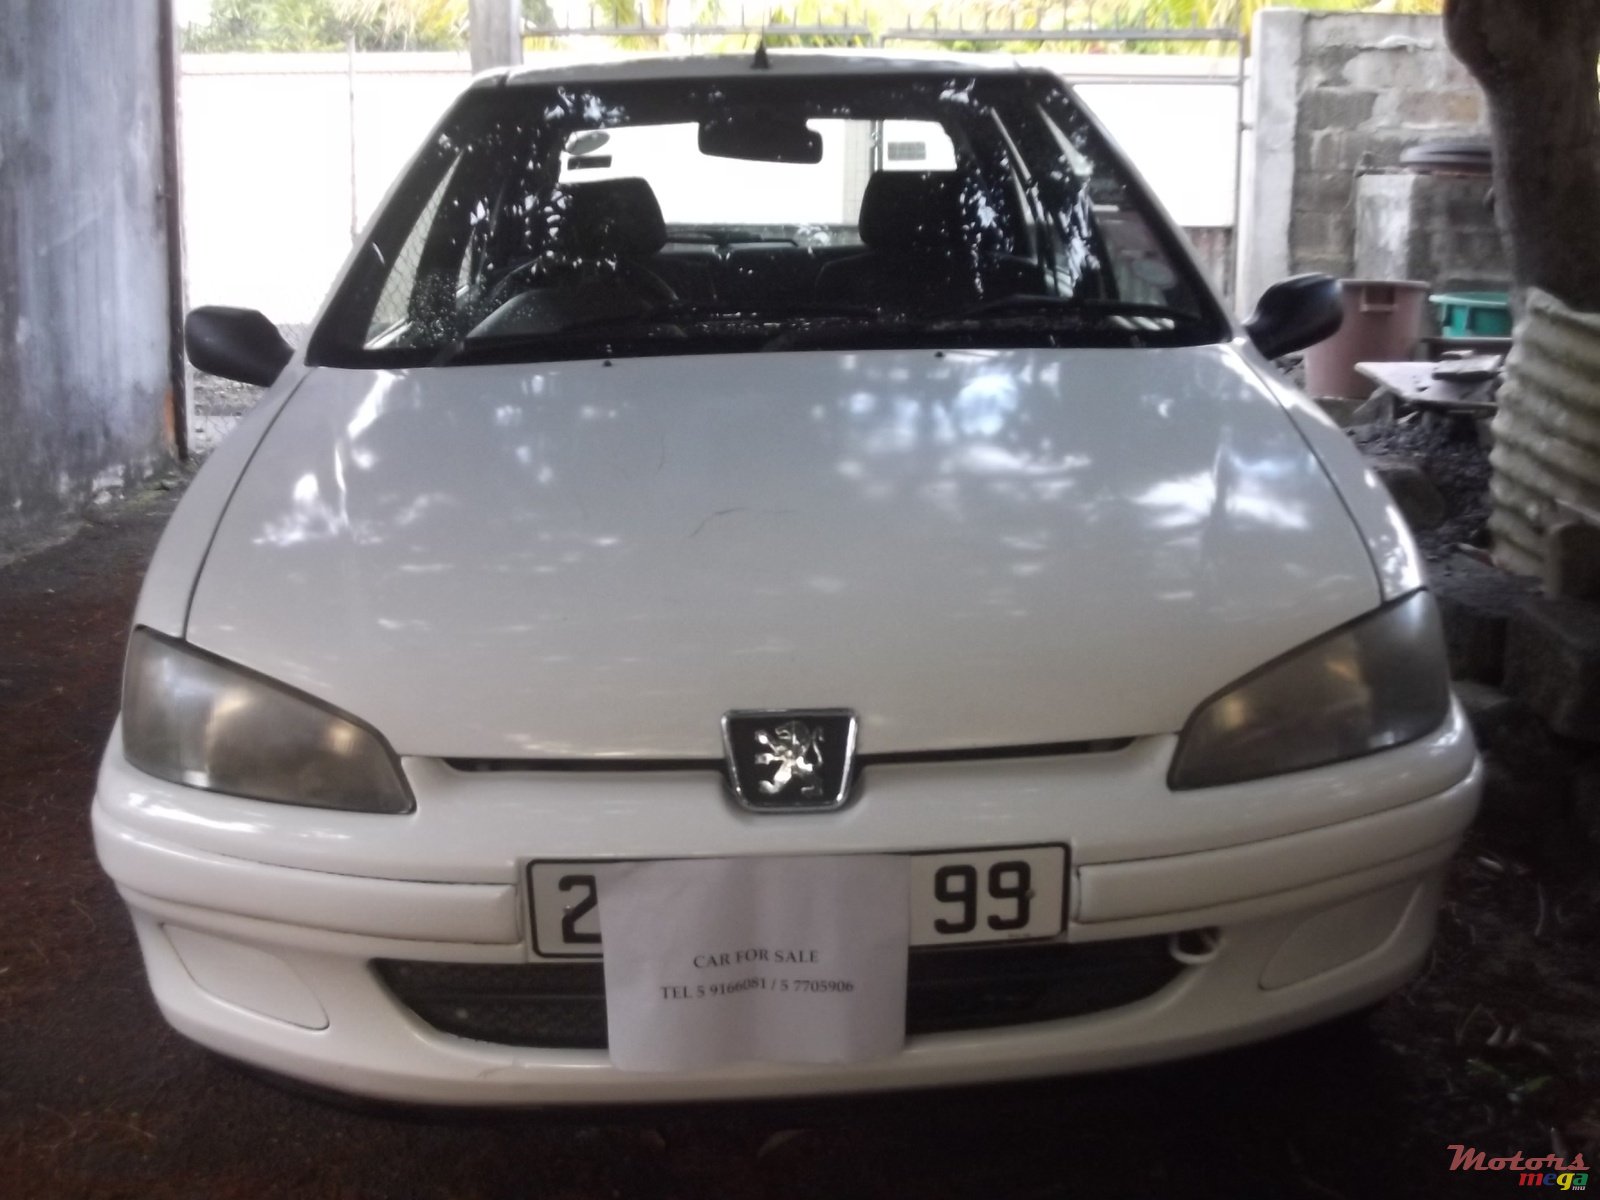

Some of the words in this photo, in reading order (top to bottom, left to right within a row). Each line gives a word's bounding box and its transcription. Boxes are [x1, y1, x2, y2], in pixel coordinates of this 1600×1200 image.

[558, 875, 602, 944] 2
[933, 860, 1032, 934] 99
[693, 953, 730, 968] CAR
[735, 948, 769, 963] FOR
[774, 950, 820, 963] SALE
[661, 986, 692, 1000] TEL
[696, 985, 706, 997] 5
[780, 979, 789, 991] 5
[794, 980, 854, 993] 7705906
